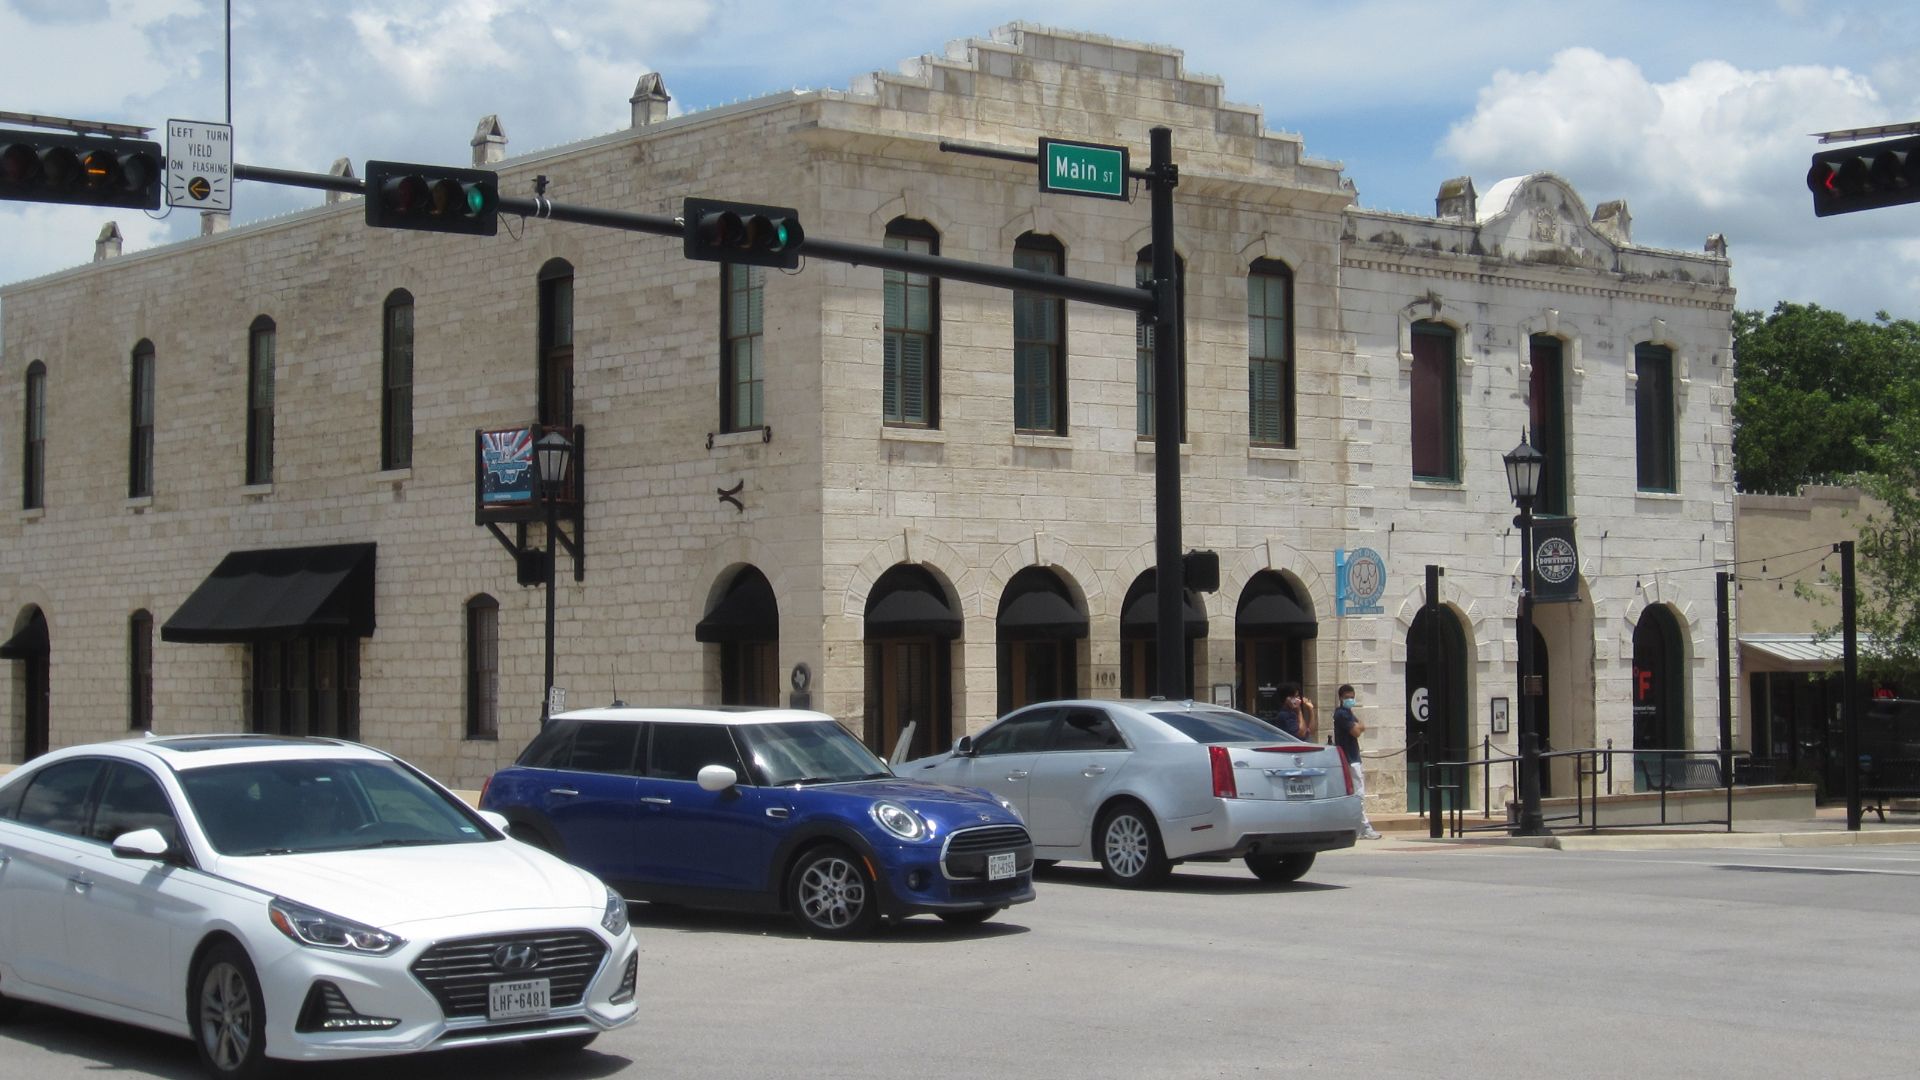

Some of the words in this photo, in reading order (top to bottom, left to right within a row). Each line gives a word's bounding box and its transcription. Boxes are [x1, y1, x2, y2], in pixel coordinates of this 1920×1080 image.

[171, 126, 193, 139] LEFT
[206, 129, 229, 142] TURN
[188, 143, 212, 158] YIELD
[170, 159, 184, 170] ON
[192, 161, 228, 174] FLASHING
[1056, 155, 1097, 181] Main
[1103, 170, 1114, 183] ST
[1539, 556, 1573, 565] DOWNTOWN
[509, 982, 532, 991] TEXAS
